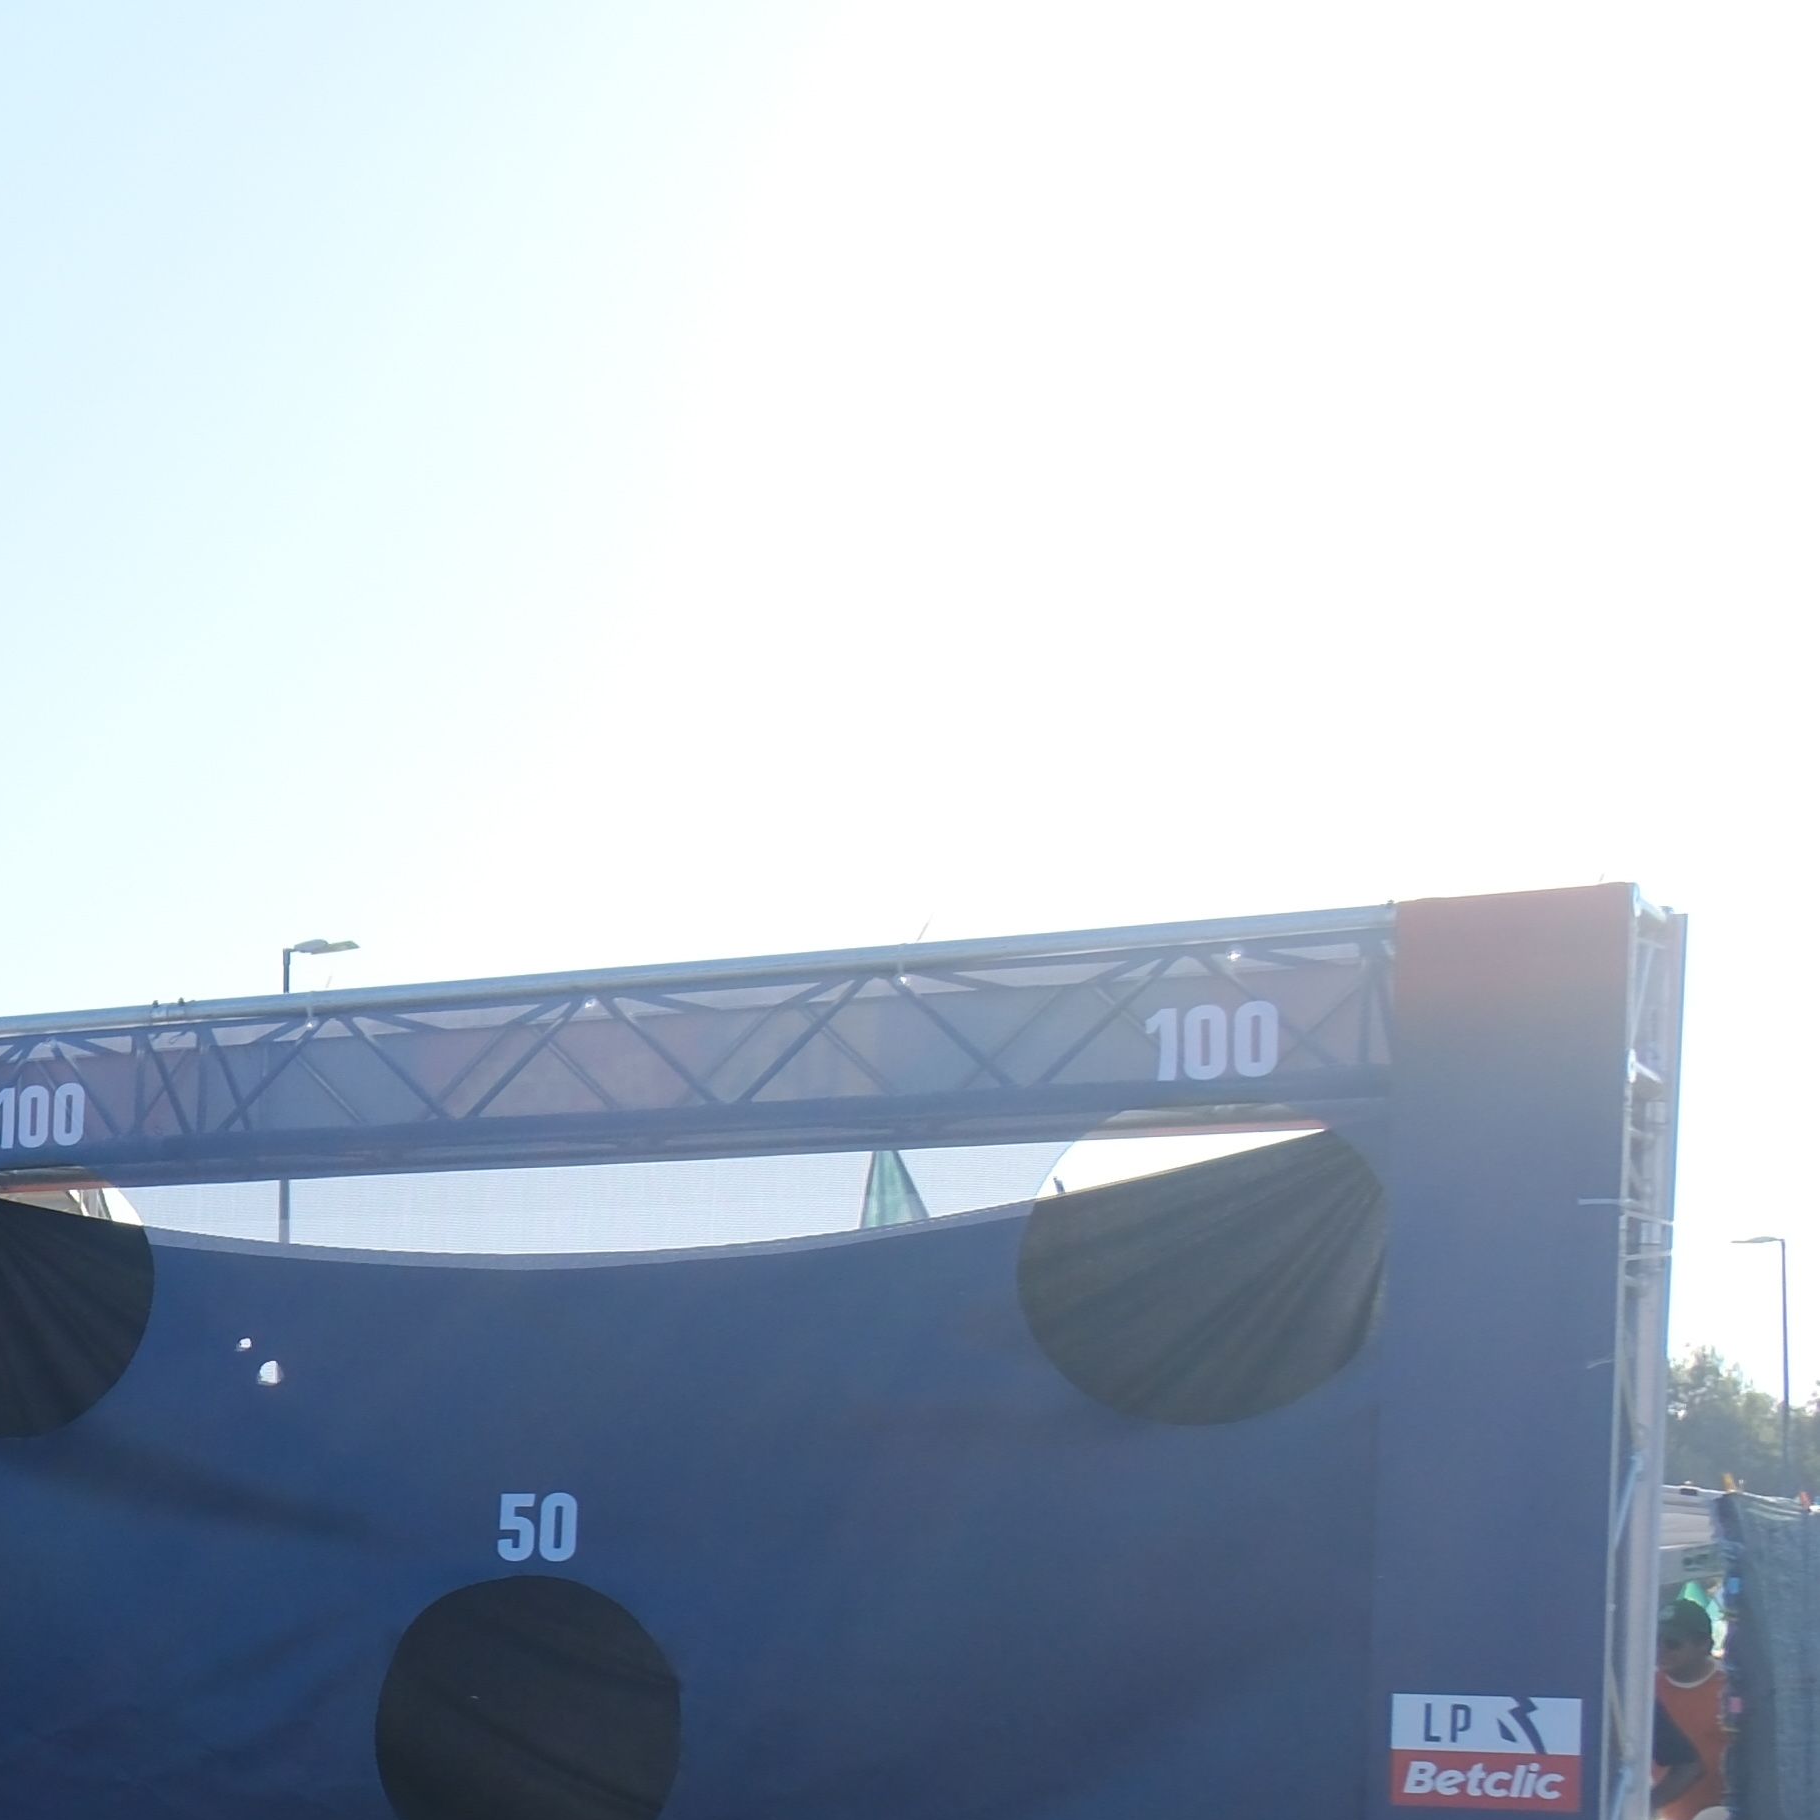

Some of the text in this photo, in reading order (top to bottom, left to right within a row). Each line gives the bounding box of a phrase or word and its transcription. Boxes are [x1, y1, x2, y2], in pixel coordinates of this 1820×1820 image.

[1145, 1000, 1279, 1081] 100
[497, 1492, 578, 1562] 50
[1423, 1703, 1472, 1743] LP
[1403, 1761, 1565, 1799] Betclic
